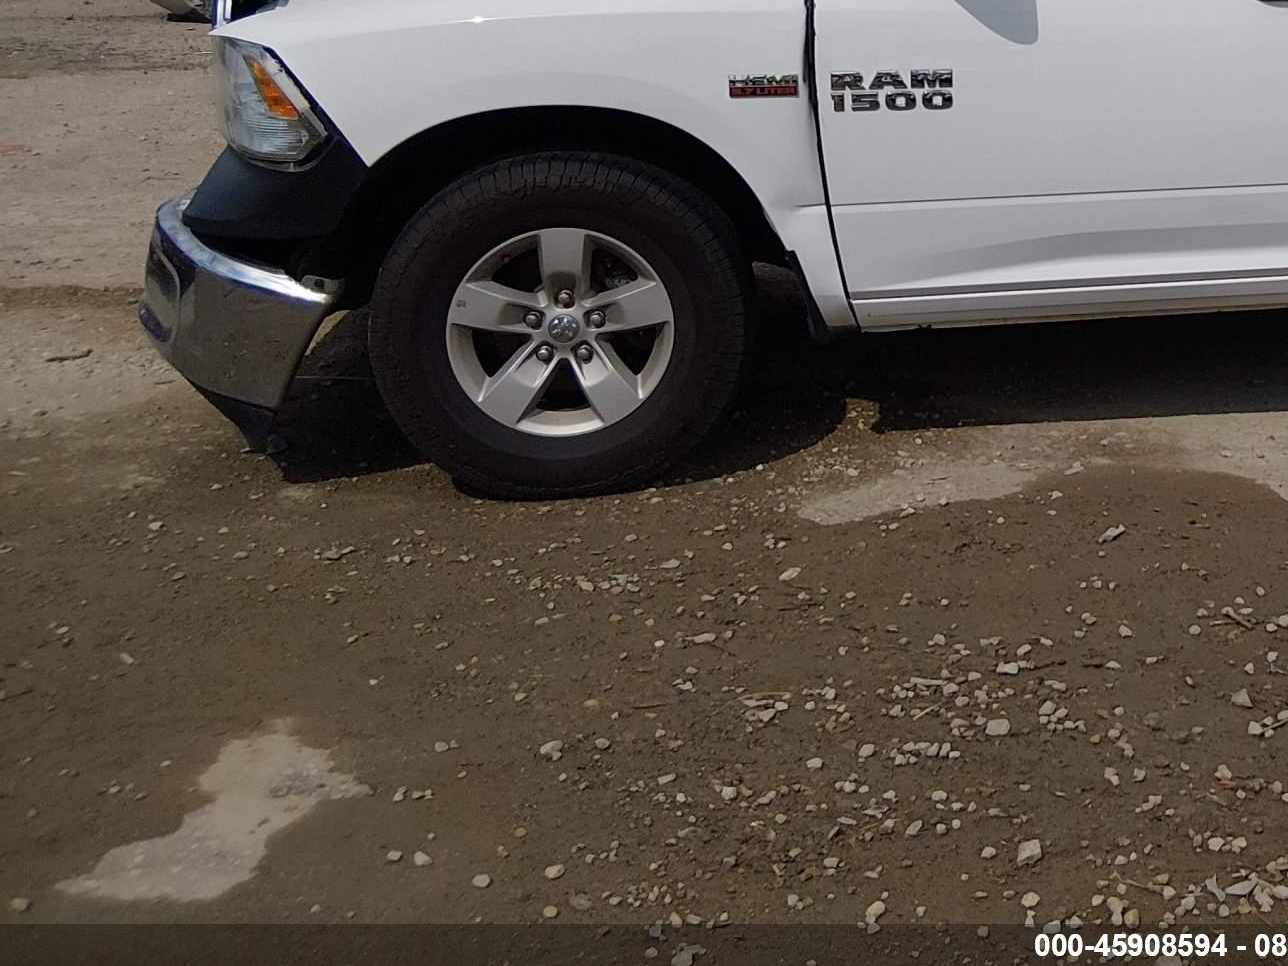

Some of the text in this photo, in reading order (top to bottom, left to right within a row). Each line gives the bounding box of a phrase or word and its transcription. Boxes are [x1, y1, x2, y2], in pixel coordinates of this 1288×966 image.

[728, 74, 798, 85] HEMI
[830, 70, 953, 90] RAM
[830, 91, 953, 112] 1500
